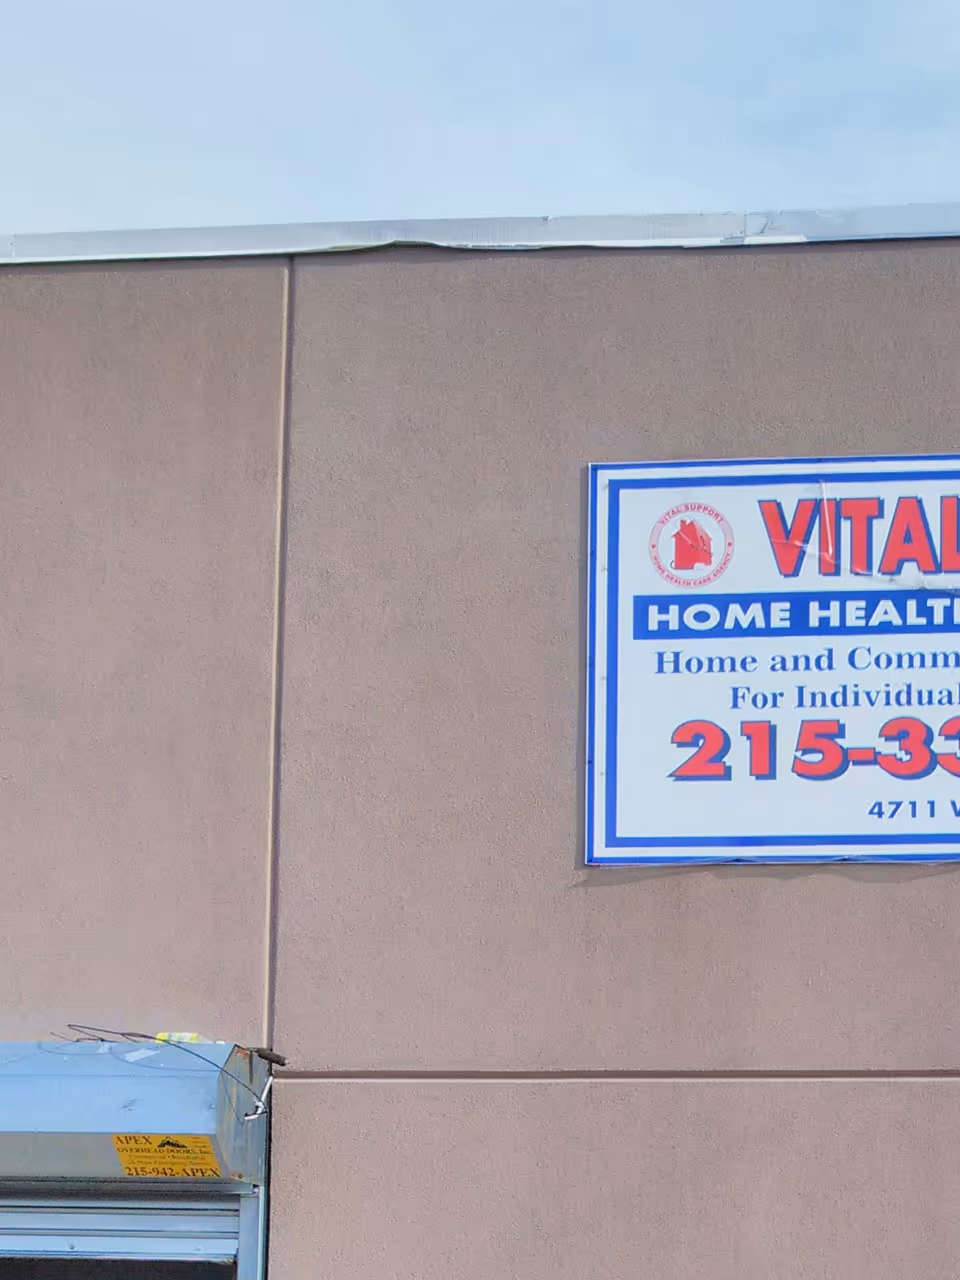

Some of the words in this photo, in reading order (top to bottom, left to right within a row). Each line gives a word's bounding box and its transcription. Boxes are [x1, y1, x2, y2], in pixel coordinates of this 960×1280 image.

[659, 507, 682, 525] VITAL
[683, 503, 725, 525] SUPPORT
[665, 573, 692, 587] HEALTH
[692, 576, 712, 587] CARE
[647, 601, 791, 631] HOME
[653, 650, 758, 674] Home
[769, 647, 834, 672] and
[730, 686, 785, 710] For
[868, 799, 937, 819] 4711
[116, 1136, 152, 1145] APEX
[125, 1166, 220, 1177] 215-942-APEX
